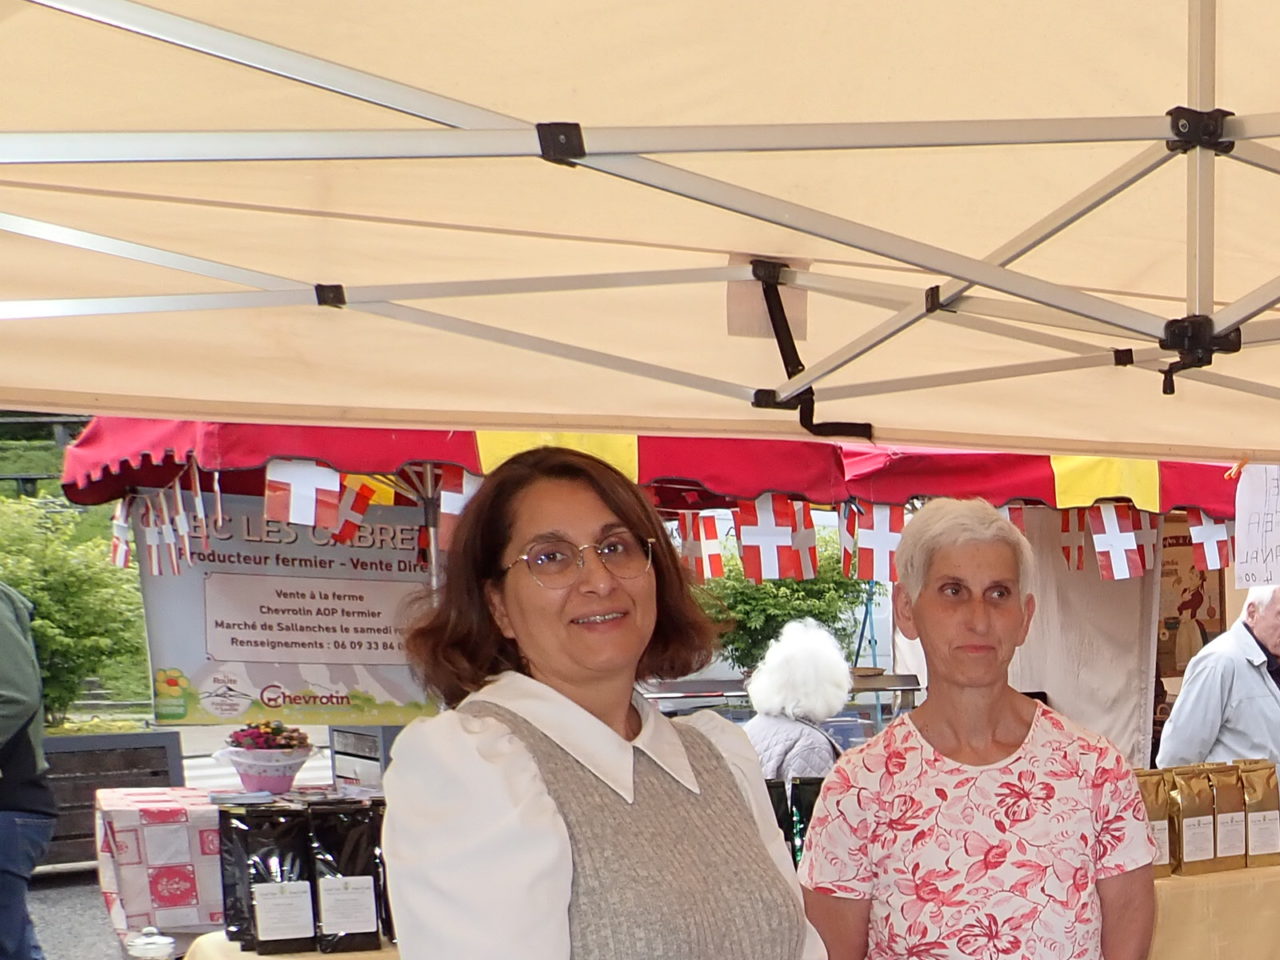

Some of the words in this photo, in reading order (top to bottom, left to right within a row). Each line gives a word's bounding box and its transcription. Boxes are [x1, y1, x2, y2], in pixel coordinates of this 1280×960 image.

[242, 514, 298, 545] LES
[178, 547, 271, 567] Producteur
[275, 553, 335, 570] fermier
[350, 557, 393, 572] Vente
[275, 589, 306, 600] Vente
[310, 590, 316, 600] à
[319, 592, 329, 601] la
[333, 592, 364, 602] ferme
[259, 605, 313, 616] Chevrotin
[316, 608, 338, 617] AOP
[341, 608, 382, 618] fermier
[215, 620, 257, 631] Marché
[261, 622, 274, 631] de
[277, 622, 337, 633] Sallanches
[340, 624, 350, 633] le
[353, 626, 392, 635] samedi
[231, 637, 324, 650] Renseignements
[333, 641, 347, 649] 06
[350, 641, 363, 650] 09
[366, 641, 379, 650] 33
[260, 684, 351, 709] Chevrotin
